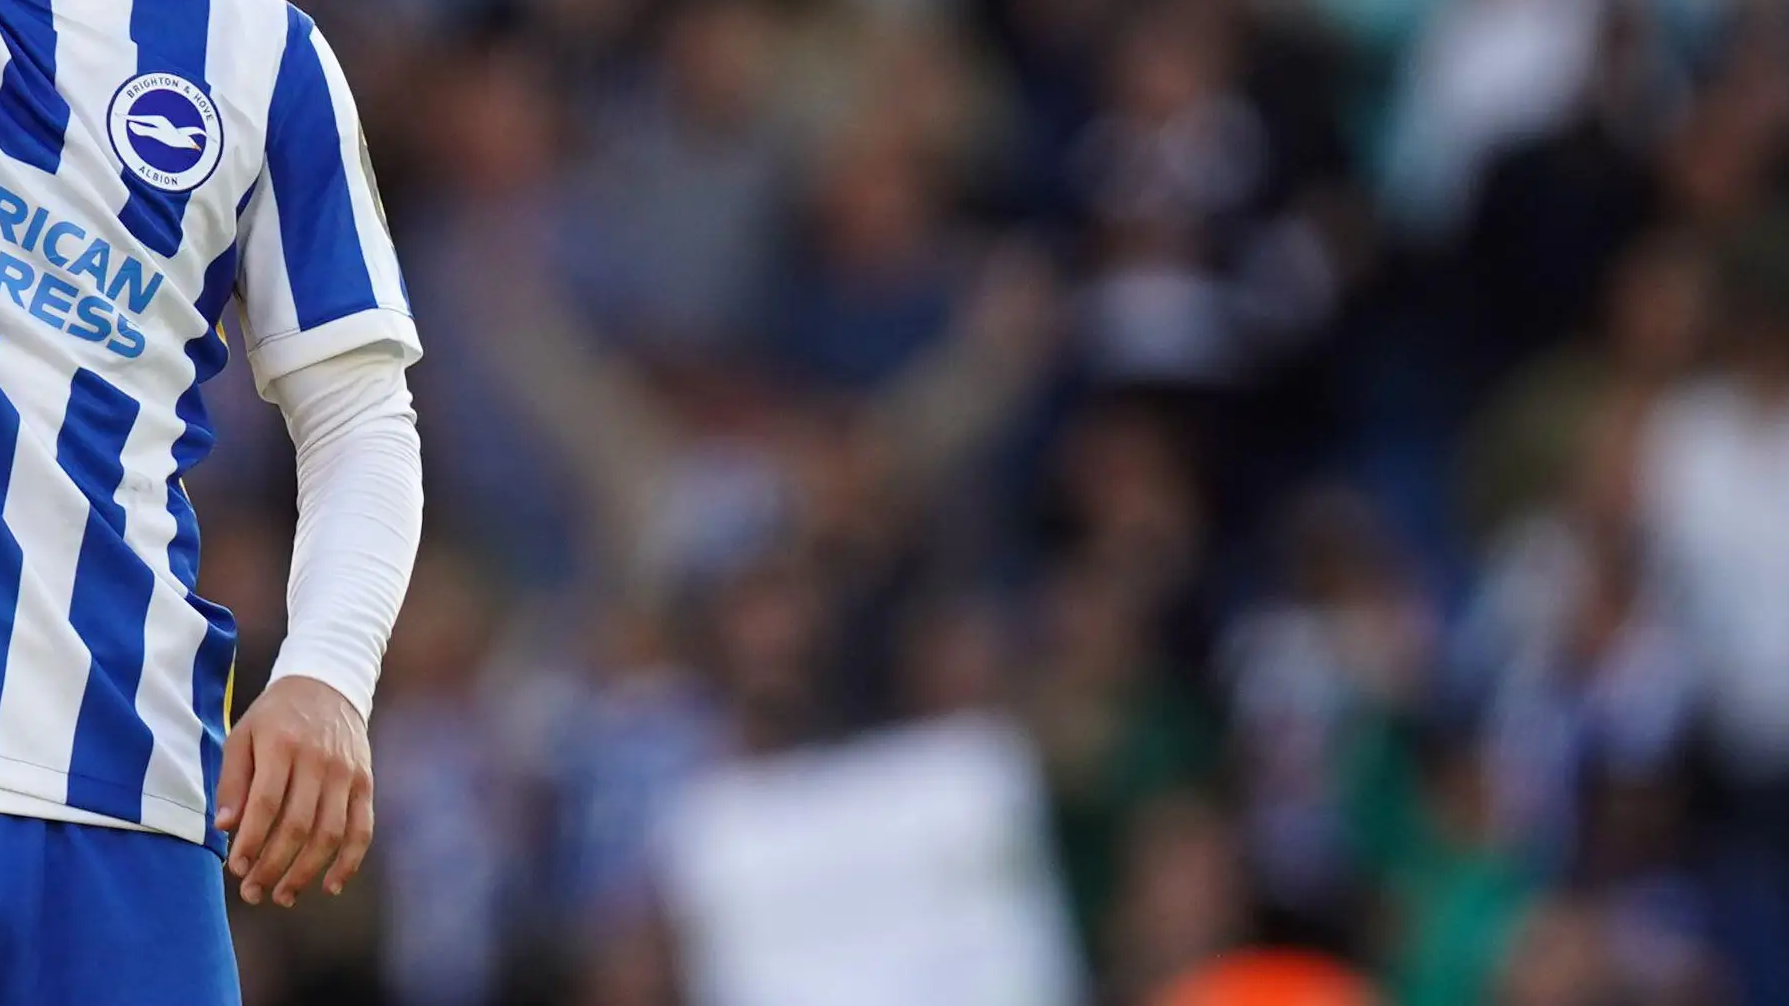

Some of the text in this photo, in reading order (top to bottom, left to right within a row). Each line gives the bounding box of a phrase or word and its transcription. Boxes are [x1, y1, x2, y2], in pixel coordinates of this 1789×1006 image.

[126, 77, 215, 122] BRIGHTON & HOVE
[138, 165, 179, 186] ALBION
